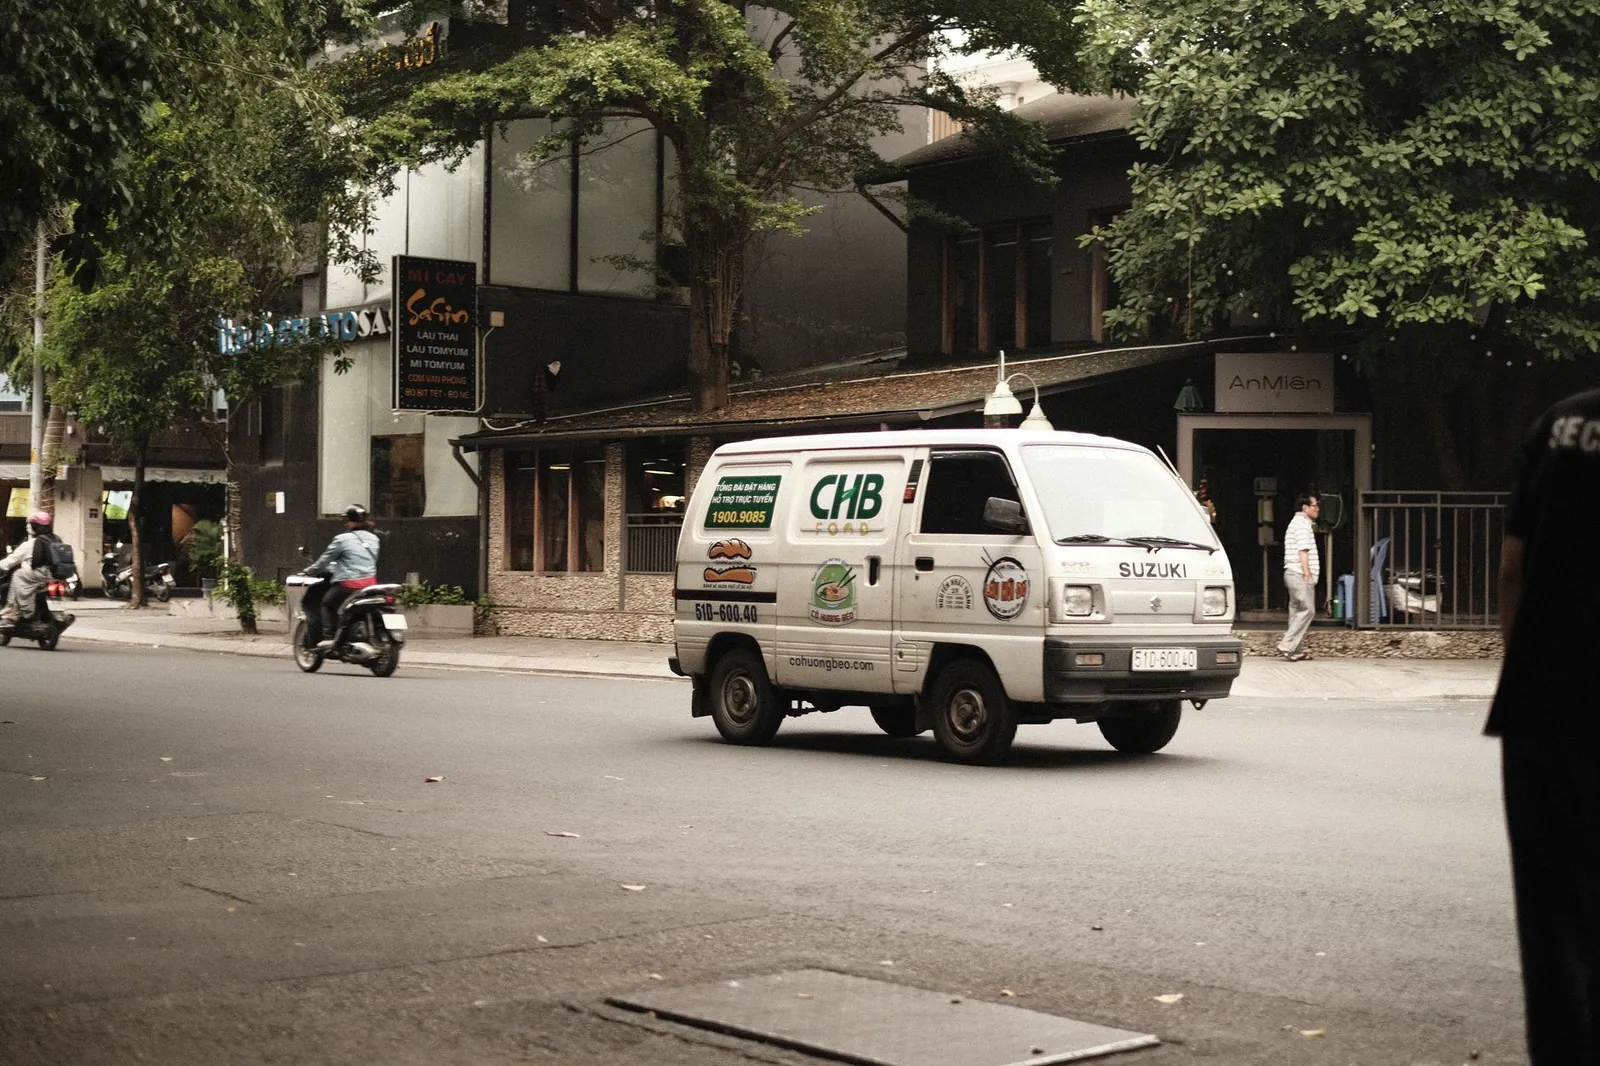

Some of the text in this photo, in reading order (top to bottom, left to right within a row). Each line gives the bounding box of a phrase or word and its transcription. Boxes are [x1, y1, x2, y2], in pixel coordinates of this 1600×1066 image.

[358, 307, 393, 338] SA
[427, 346, 469, 356] TOMYUM
[423, 360, 466, 370] TOMYUM
[809, 474, 885, 520] CHB
[712, 511, 767, 523] 1900.9085
[1119, 562, 1188, 579] SUZUKI
[695, 603, 758, 624] 51D-600.40
[789, 655, 874, 671] cohuongbeo.com
